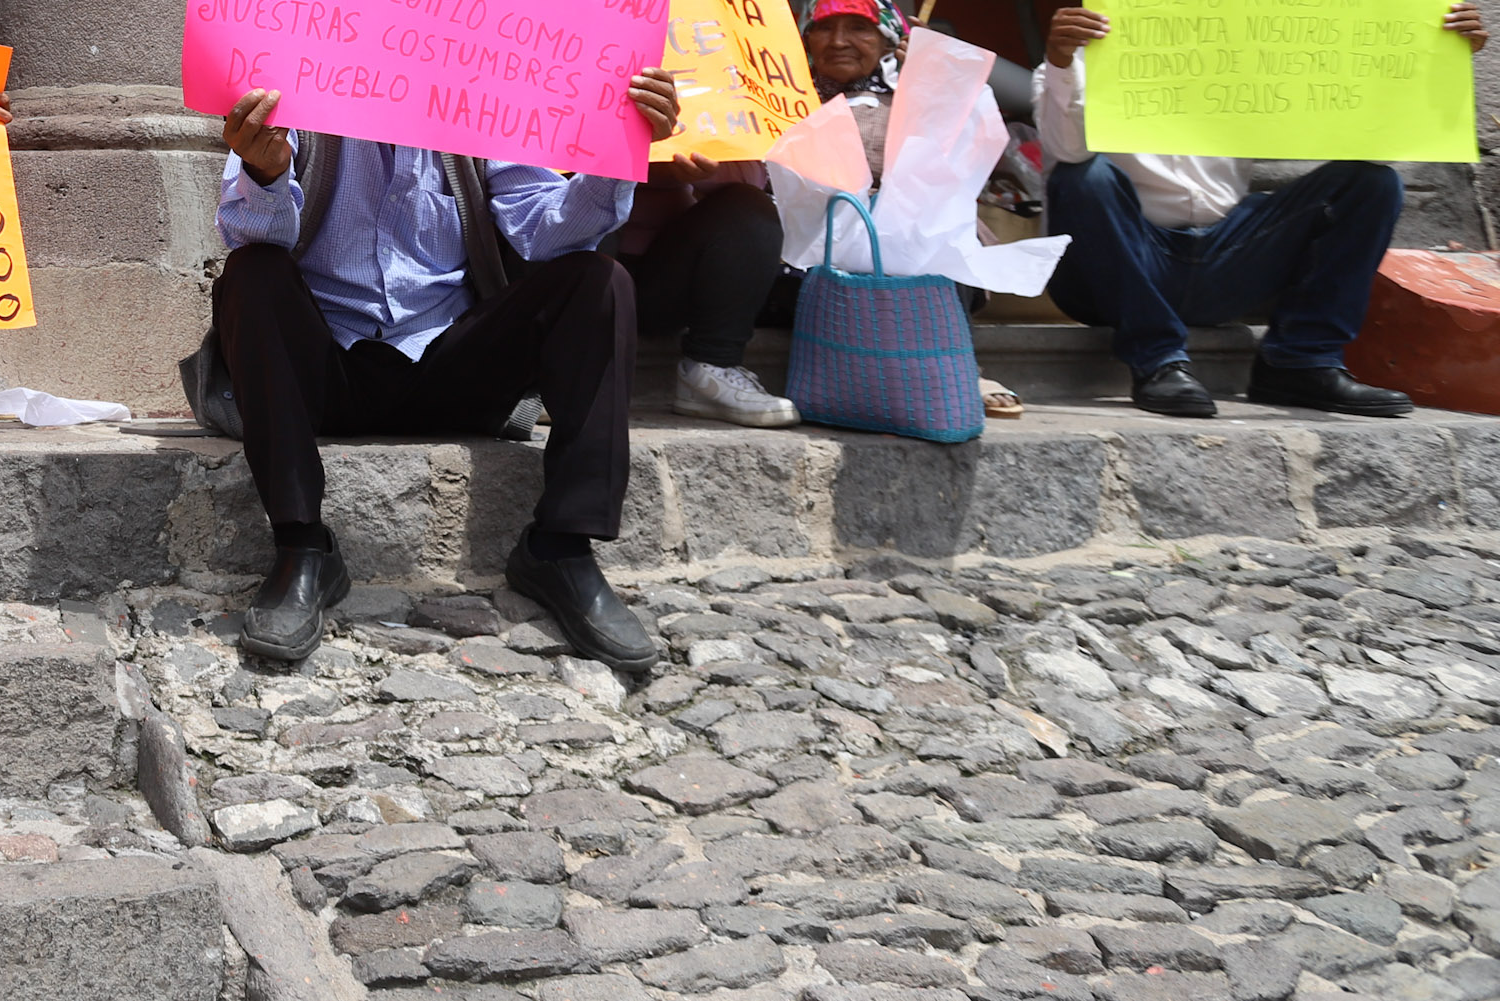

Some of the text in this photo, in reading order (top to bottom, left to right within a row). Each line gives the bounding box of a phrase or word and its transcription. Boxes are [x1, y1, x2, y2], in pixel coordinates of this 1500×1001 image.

[498, 15, 583, 62] COMO
[596, 43, 646, 79] EN
[1119, 16, 1417, 47] AUTONOMIA NOSOTROS HEMOS
[226, 48, 271, 88] DE
[295, 57, 409, 102] PUEBLO
[383, 24, 581, 98] COSTUMBRES
[597, 82, 630, 120] DE
[1118, 48, 1418, 81] CUIDADO DE NUESTRO TEMPLO
[1123, 82, 1364, 119] DESDE SIGLOS ATRAS
